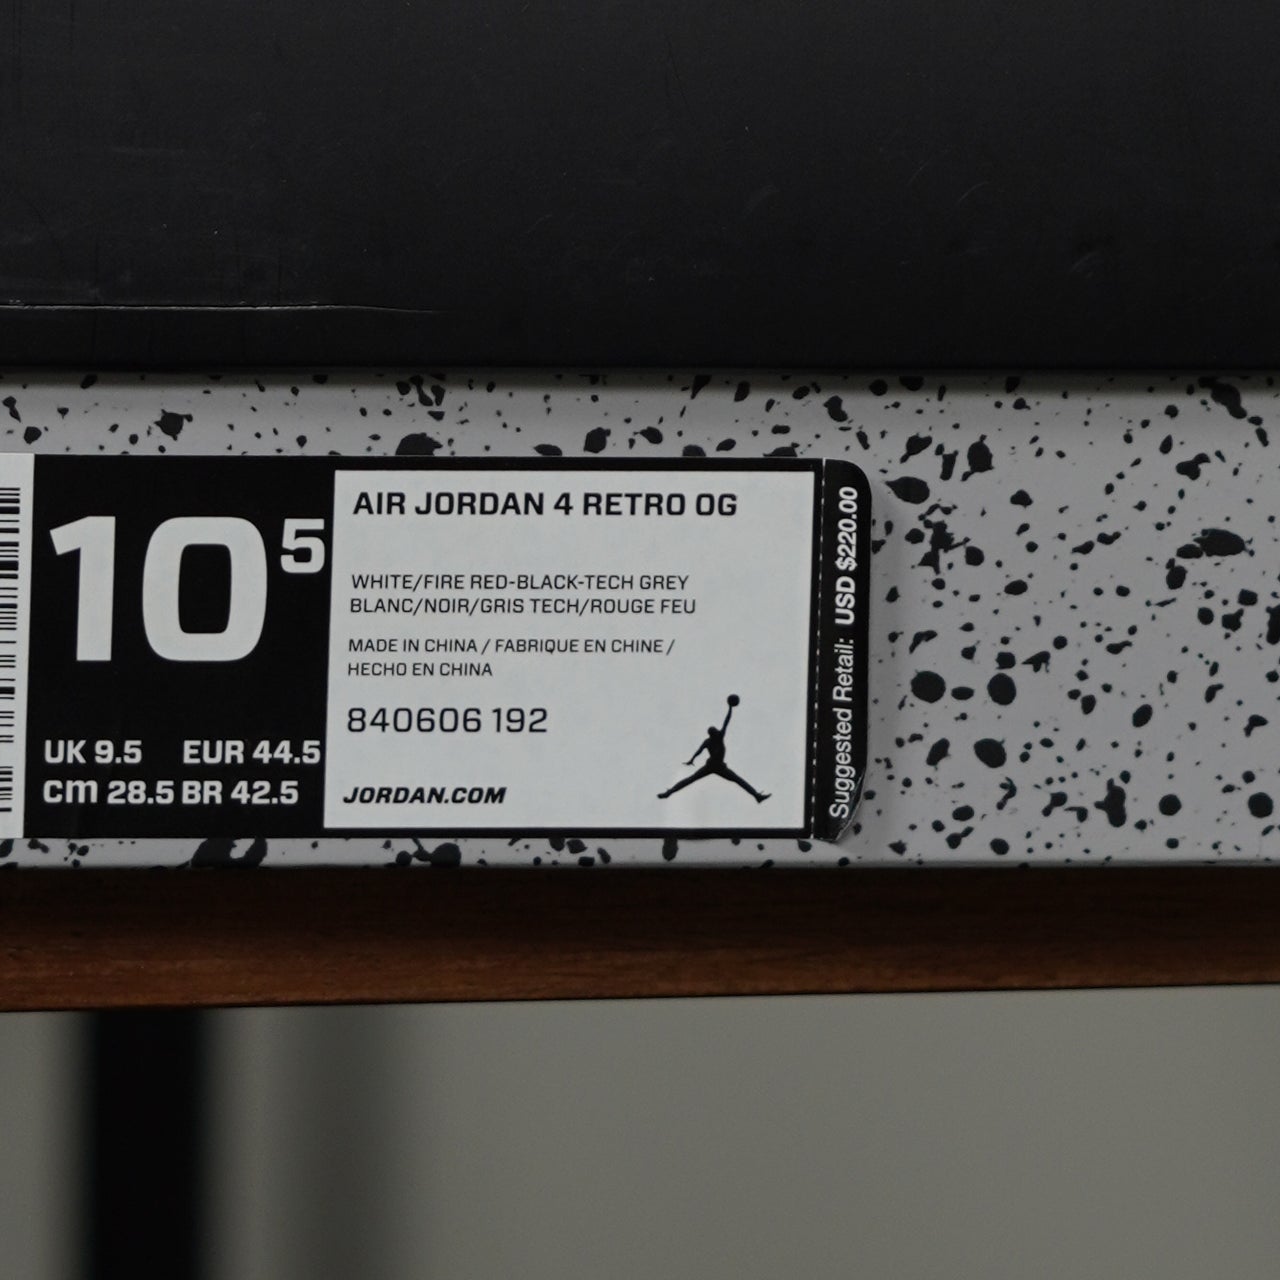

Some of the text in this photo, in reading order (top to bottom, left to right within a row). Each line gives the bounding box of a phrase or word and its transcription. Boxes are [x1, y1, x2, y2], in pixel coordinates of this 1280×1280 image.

[352, 491, 737, 517] AIR JORDAN 4 RETRO OG
[351, 574, 689, 593] WHITE/FIRE RED-BLACK-TECH GREY
[350, 597, 696, 617] BLANC/NOIR/GRIS TECH/ROUGE FEU
[348, 638, 398, 653] MADE
[402, 638, 420, 653] IN
[424, 638, 478, 653] CHINA
[495, 638, 580, 655] FABRIQUE
[583, 638, 607, 653] EN
[611, 638, 664, 654] CHINE
[828, 486, 858, 819] Suggested Retail: USD $220.00
[347, 662, 493, 677] HECHO EN CHINA
[347, 707, 548, 733] 840606 192
[44, 739, 142, 764] UK 9.5
[182, 739, 321, 765] EUR 44.5
[106, 780, 175, 805] 28.5
[181, 780, 299, 805] BR 42.5
[342, 786, 507, 805] JORDAN.COM
